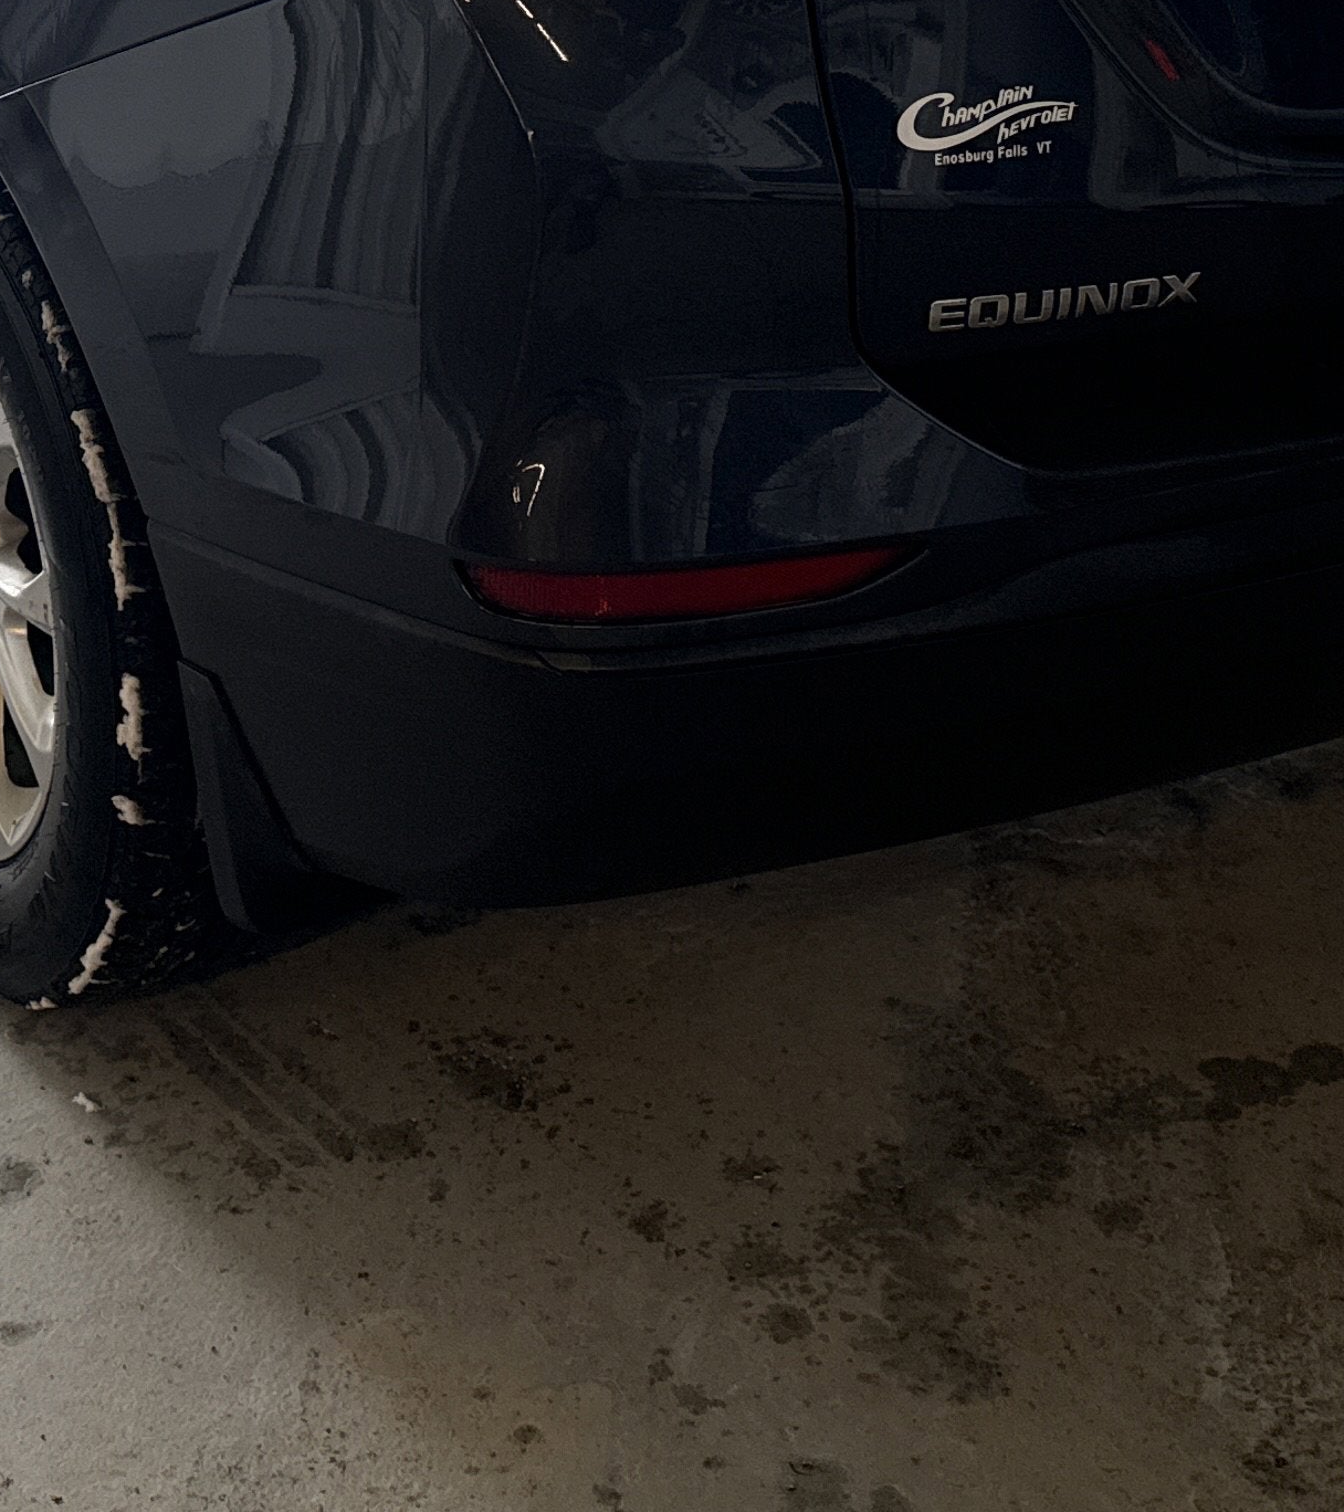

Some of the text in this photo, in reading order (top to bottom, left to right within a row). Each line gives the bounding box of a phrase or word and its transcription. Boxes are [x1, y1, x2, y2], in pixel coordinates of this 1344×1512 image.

[935, 141, 1052, 166] Enosburg Falls VT
[927, 270, 1202, 333] EQUINOX
